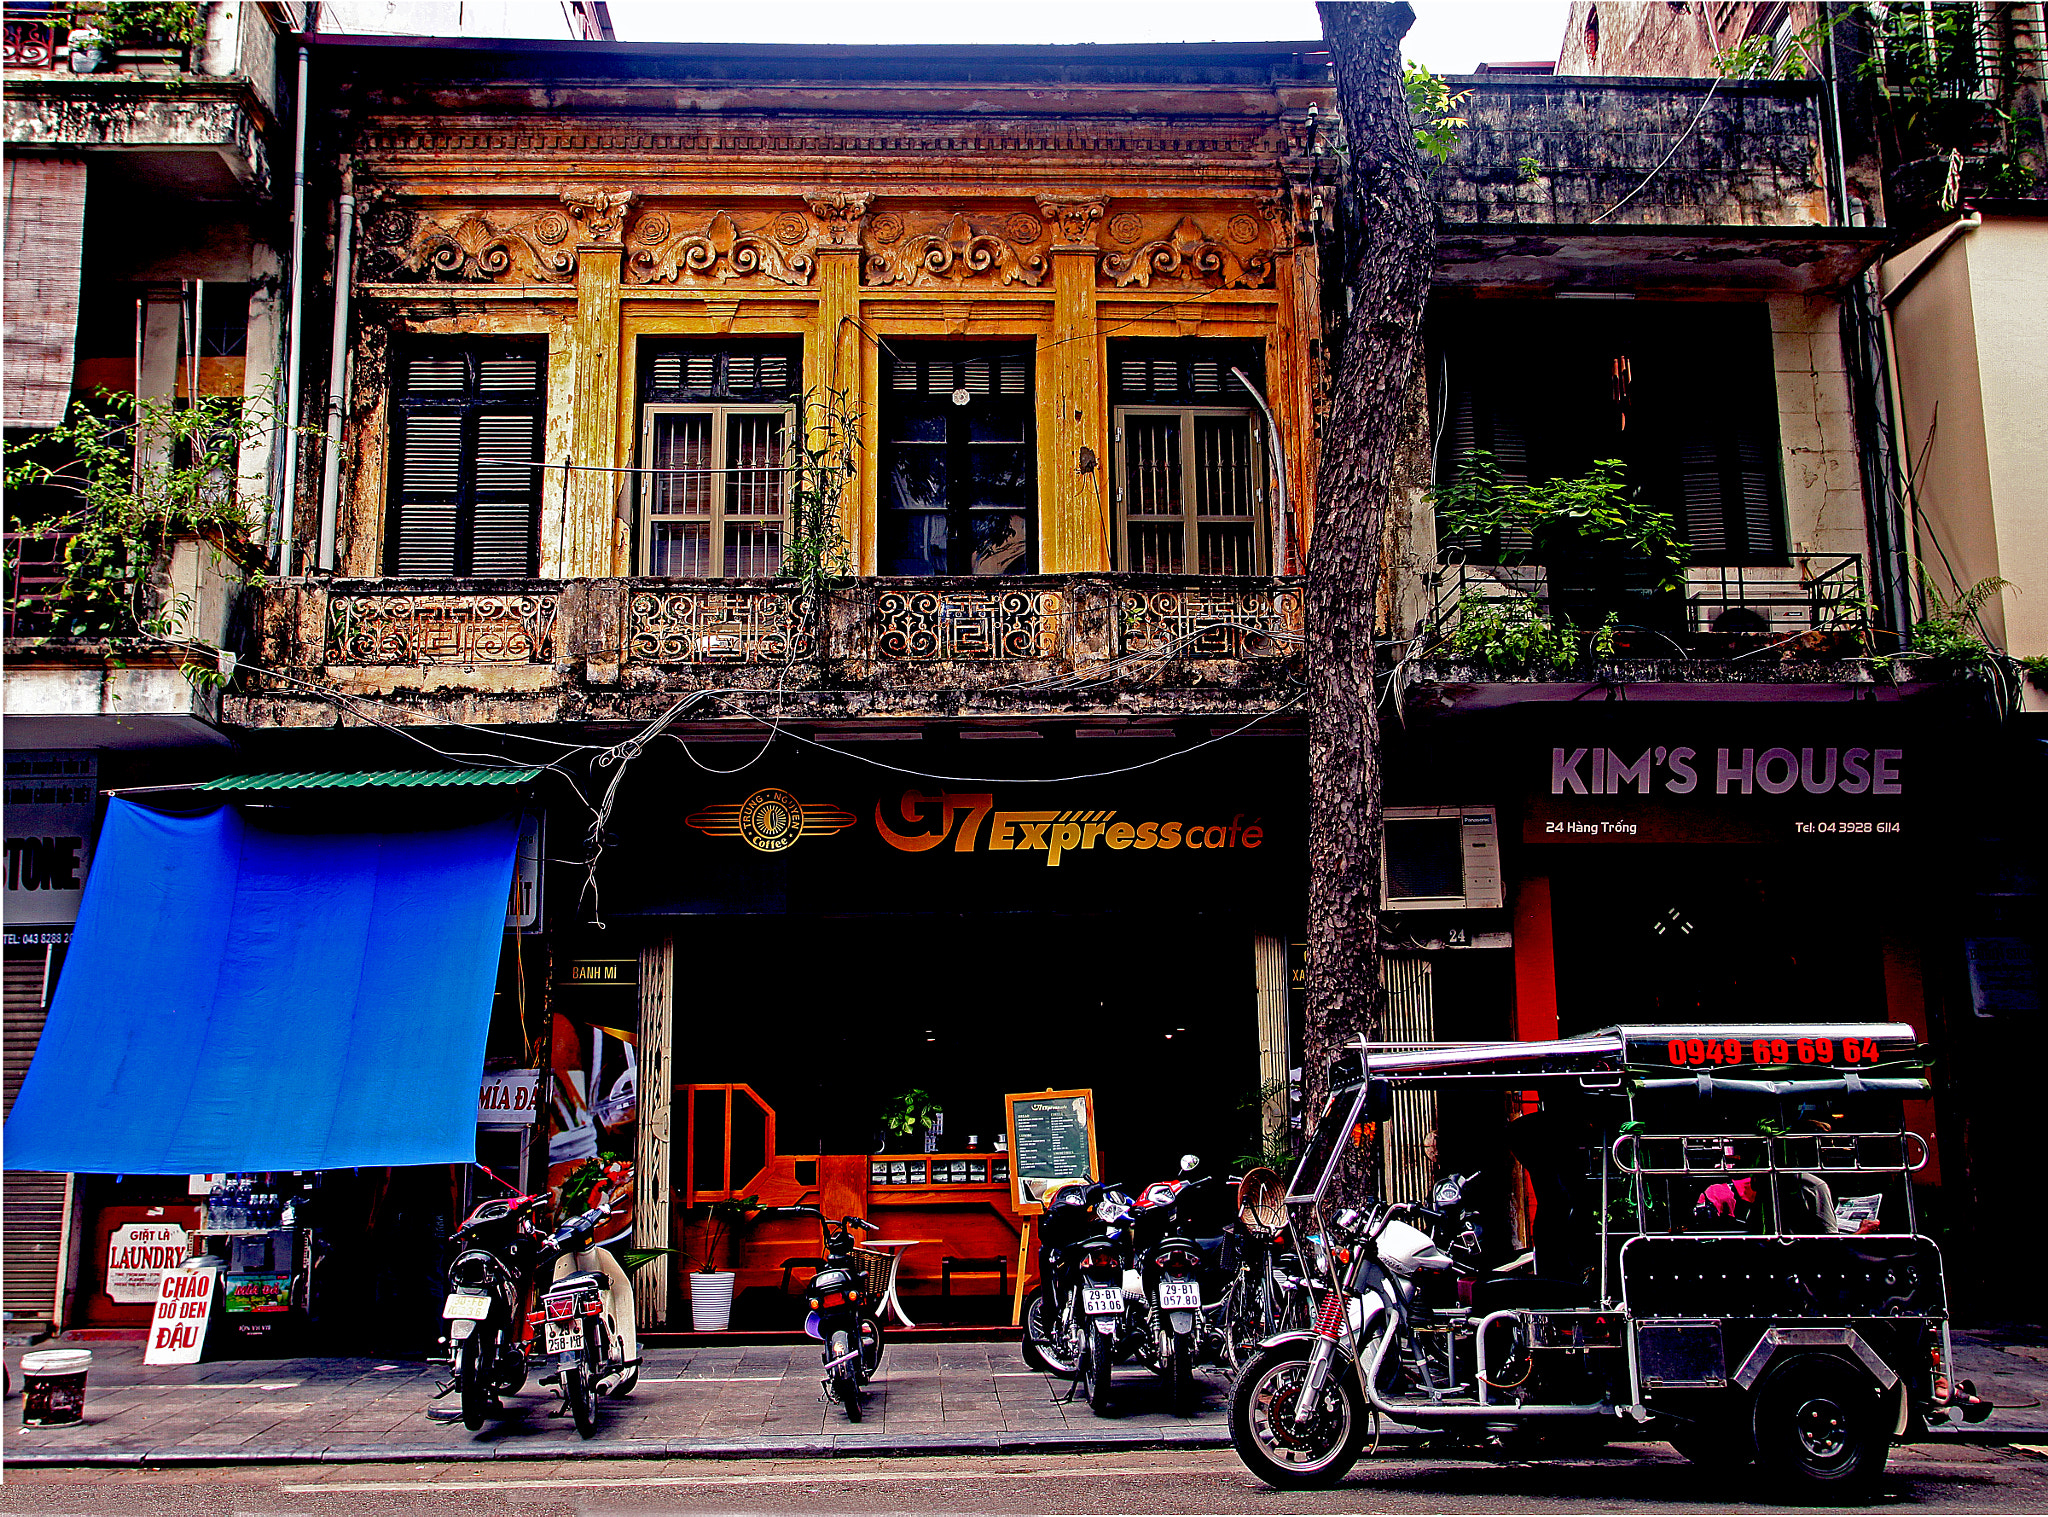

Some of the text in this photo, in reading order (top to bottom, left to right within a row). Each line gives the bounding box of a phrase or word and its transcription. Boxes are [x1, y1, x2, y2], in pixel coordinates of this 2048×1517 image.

[1551, 746, 1903, 795] KIM'S HOUSE
[875, 788, 1264, 867] G7 Express café
[1545, 821, 1565, 834] 24
[1567, 820, 1598, 836] Hàng
[1795, 821, 1901, 833] Tel: 04 3928 6114
[752, 836, 789, 850] Coffee
[1449, 928, 1466, 942] 24
[1668, 1037, 1880, 1065] 0949 69 69 64
[158, 1228, 170, 1241] LÀ
[110, 1246, 187, 1269] LAUNDRY
[162, 1271, 210, 1298] CHÁO
[1165, 1285, 1193, 1295] 29-B1
[1089, 1290, 1117, 1300] 29-B1
[1163, 1295, 1198, 1306] 057.80
[179, 1301, 208, 1319] ĐEN
[1087, 1300, 1122, 1312] 613.06
[155, 1321, 199, 1352] ĐẬU
